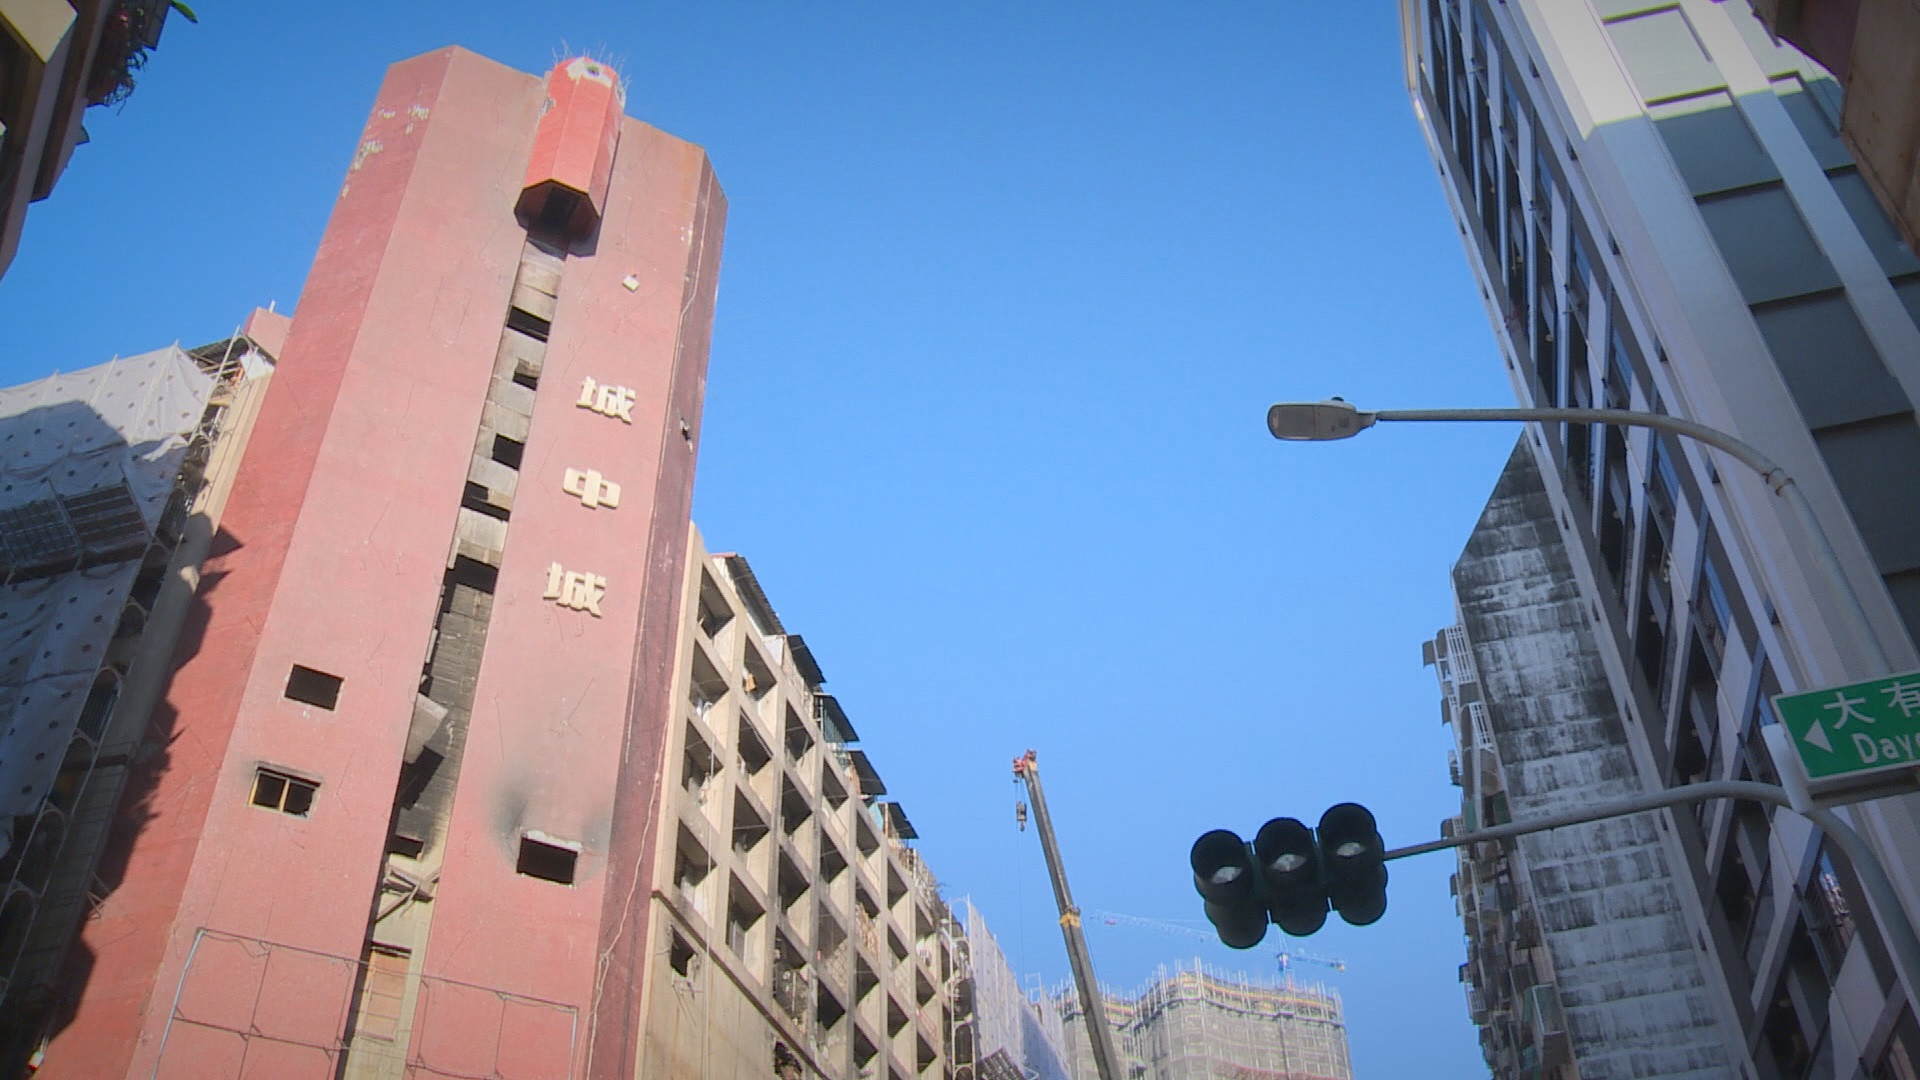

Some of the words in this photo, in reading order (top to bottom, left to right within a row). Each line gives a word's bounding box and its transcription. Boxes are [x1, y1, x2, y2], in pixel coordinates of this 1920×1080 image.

[543, 376, 636, 618] 城中城
[1823, 681, 1920, 729] 大有
